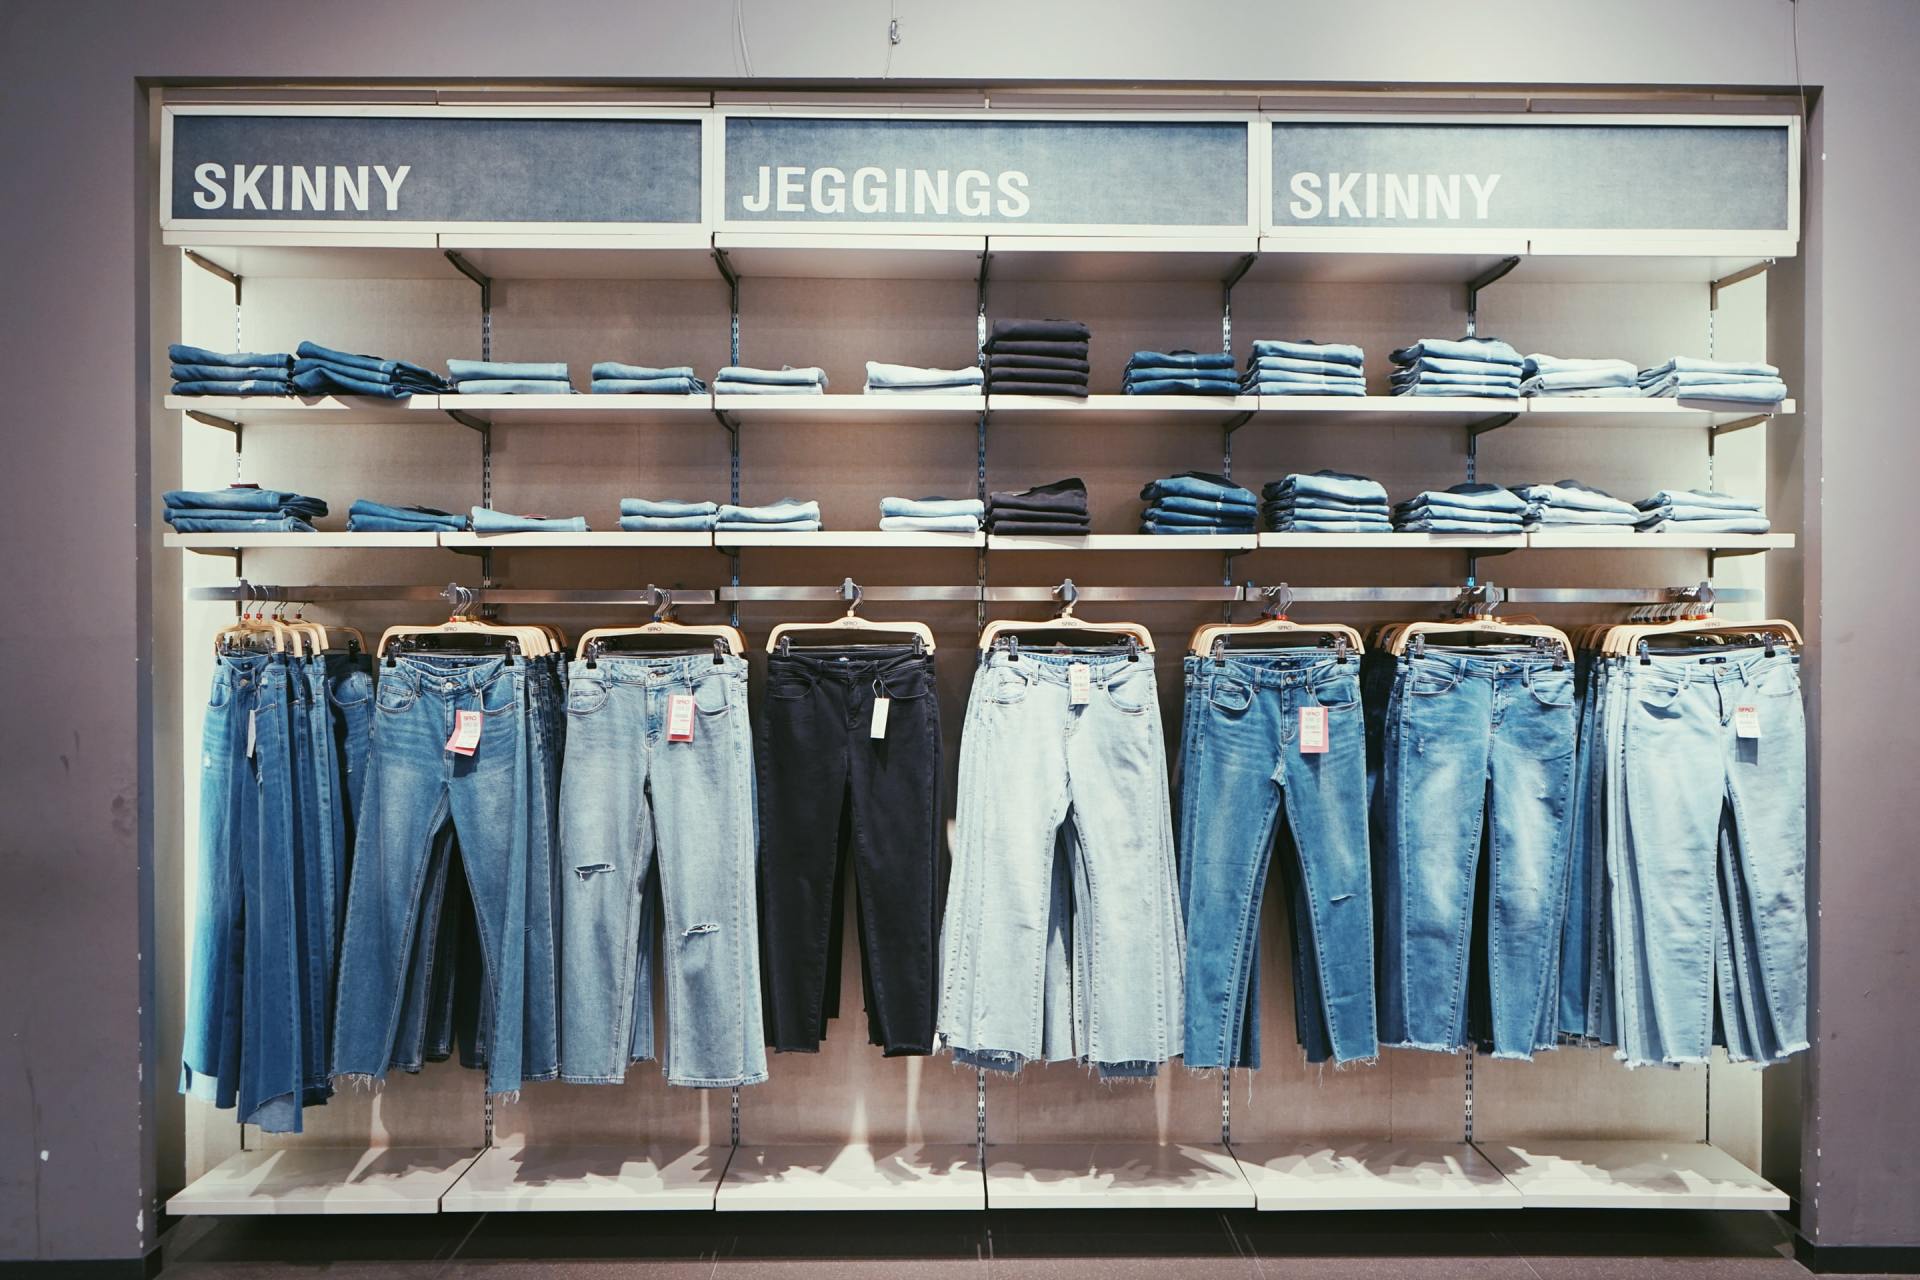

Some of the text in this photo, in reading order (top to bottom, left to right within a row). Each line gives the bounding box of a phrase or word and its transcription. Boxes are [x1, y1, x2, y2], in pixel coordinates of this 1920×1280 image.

[193, 162, 412, 211] SKINNY
[742, 166, 1031, 218] JEGGINGS
[1289, 171, 1502, 220] SKINNY
